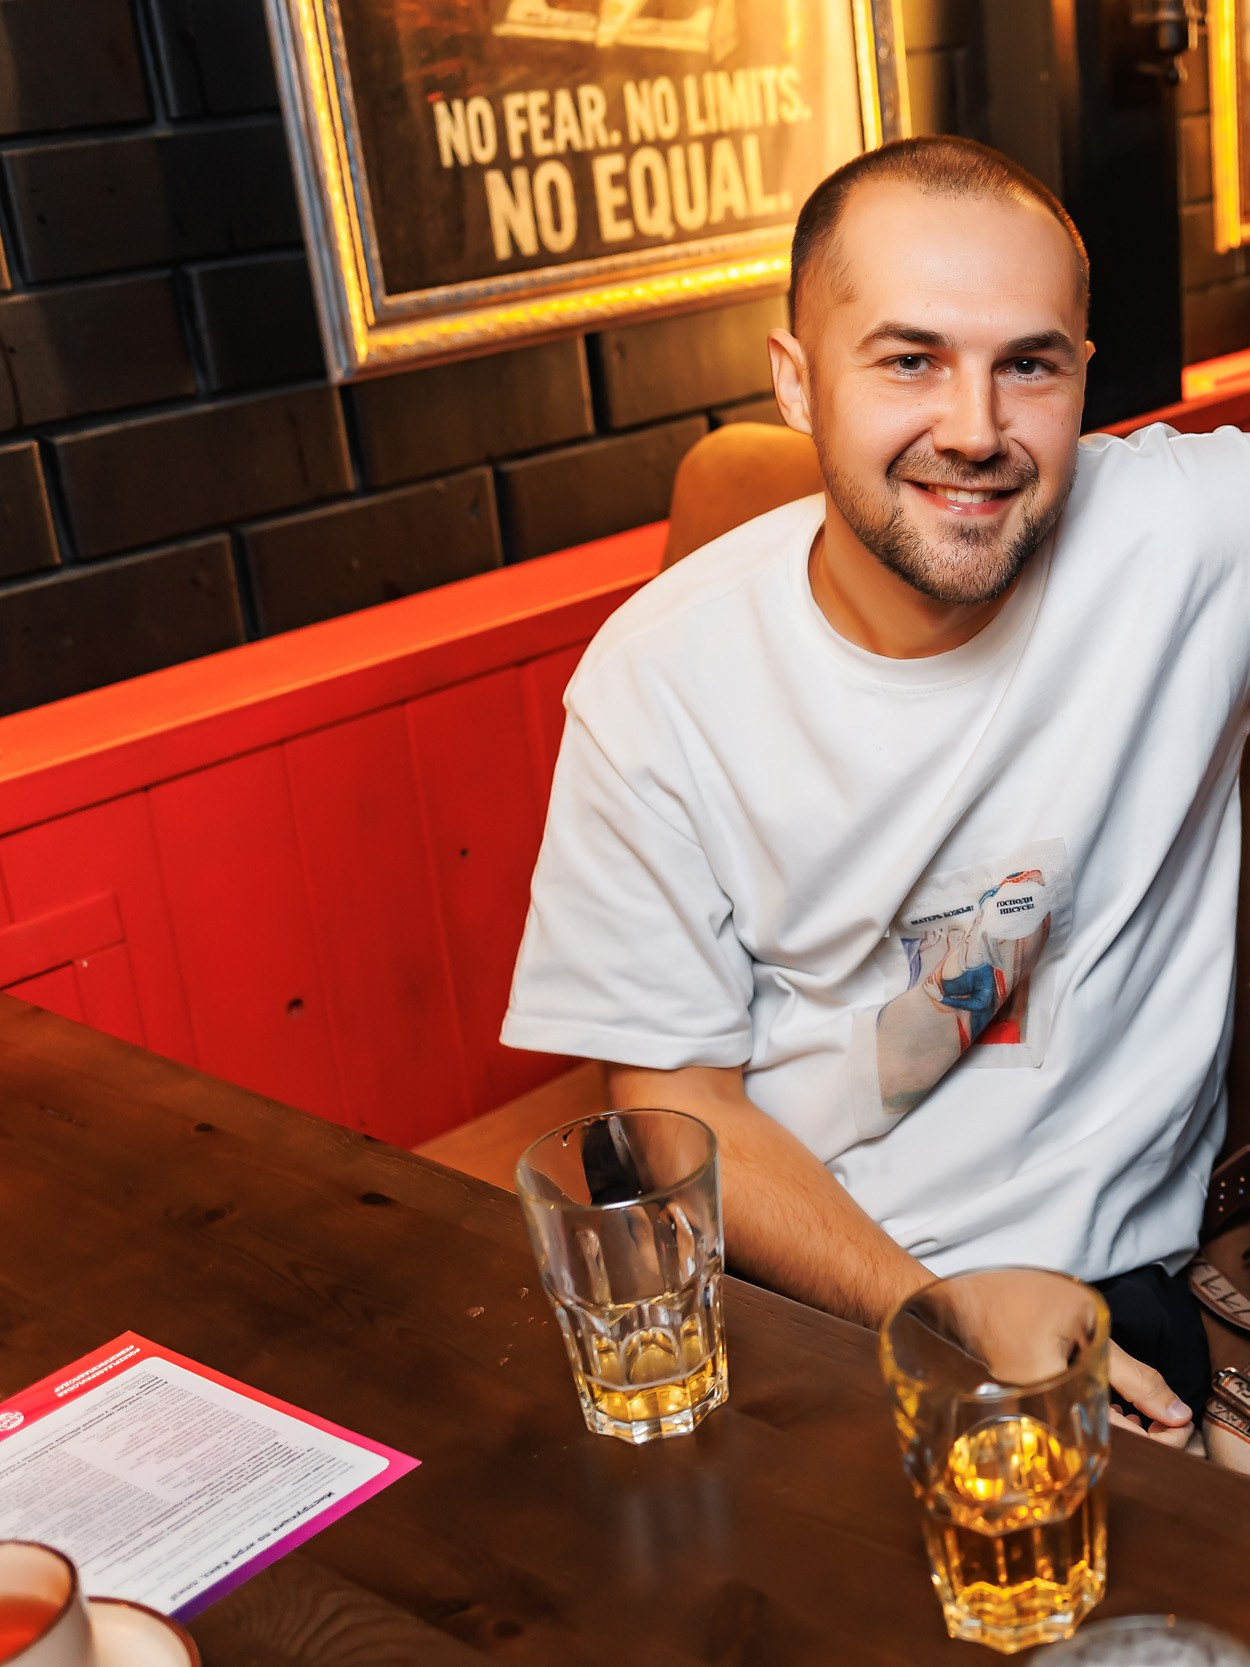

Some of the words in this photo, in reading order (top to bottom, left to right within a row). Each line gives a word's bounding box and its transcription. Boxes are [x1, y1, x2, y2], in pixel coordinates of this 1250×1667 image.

[434, 94, 497, 168] NO
[504, 83, 622, 158] FEAR.
[624, 75, 680, 145] NO
[686, 63, 812, 138] LIMITS.
[484, 159, 579, 262] NO
[593, 133, 793, 244] EQUAL.
[910, 913, 943, 926] МАТЕРЬ
[996, 896, 1034, 909] ГОСПОДИ
